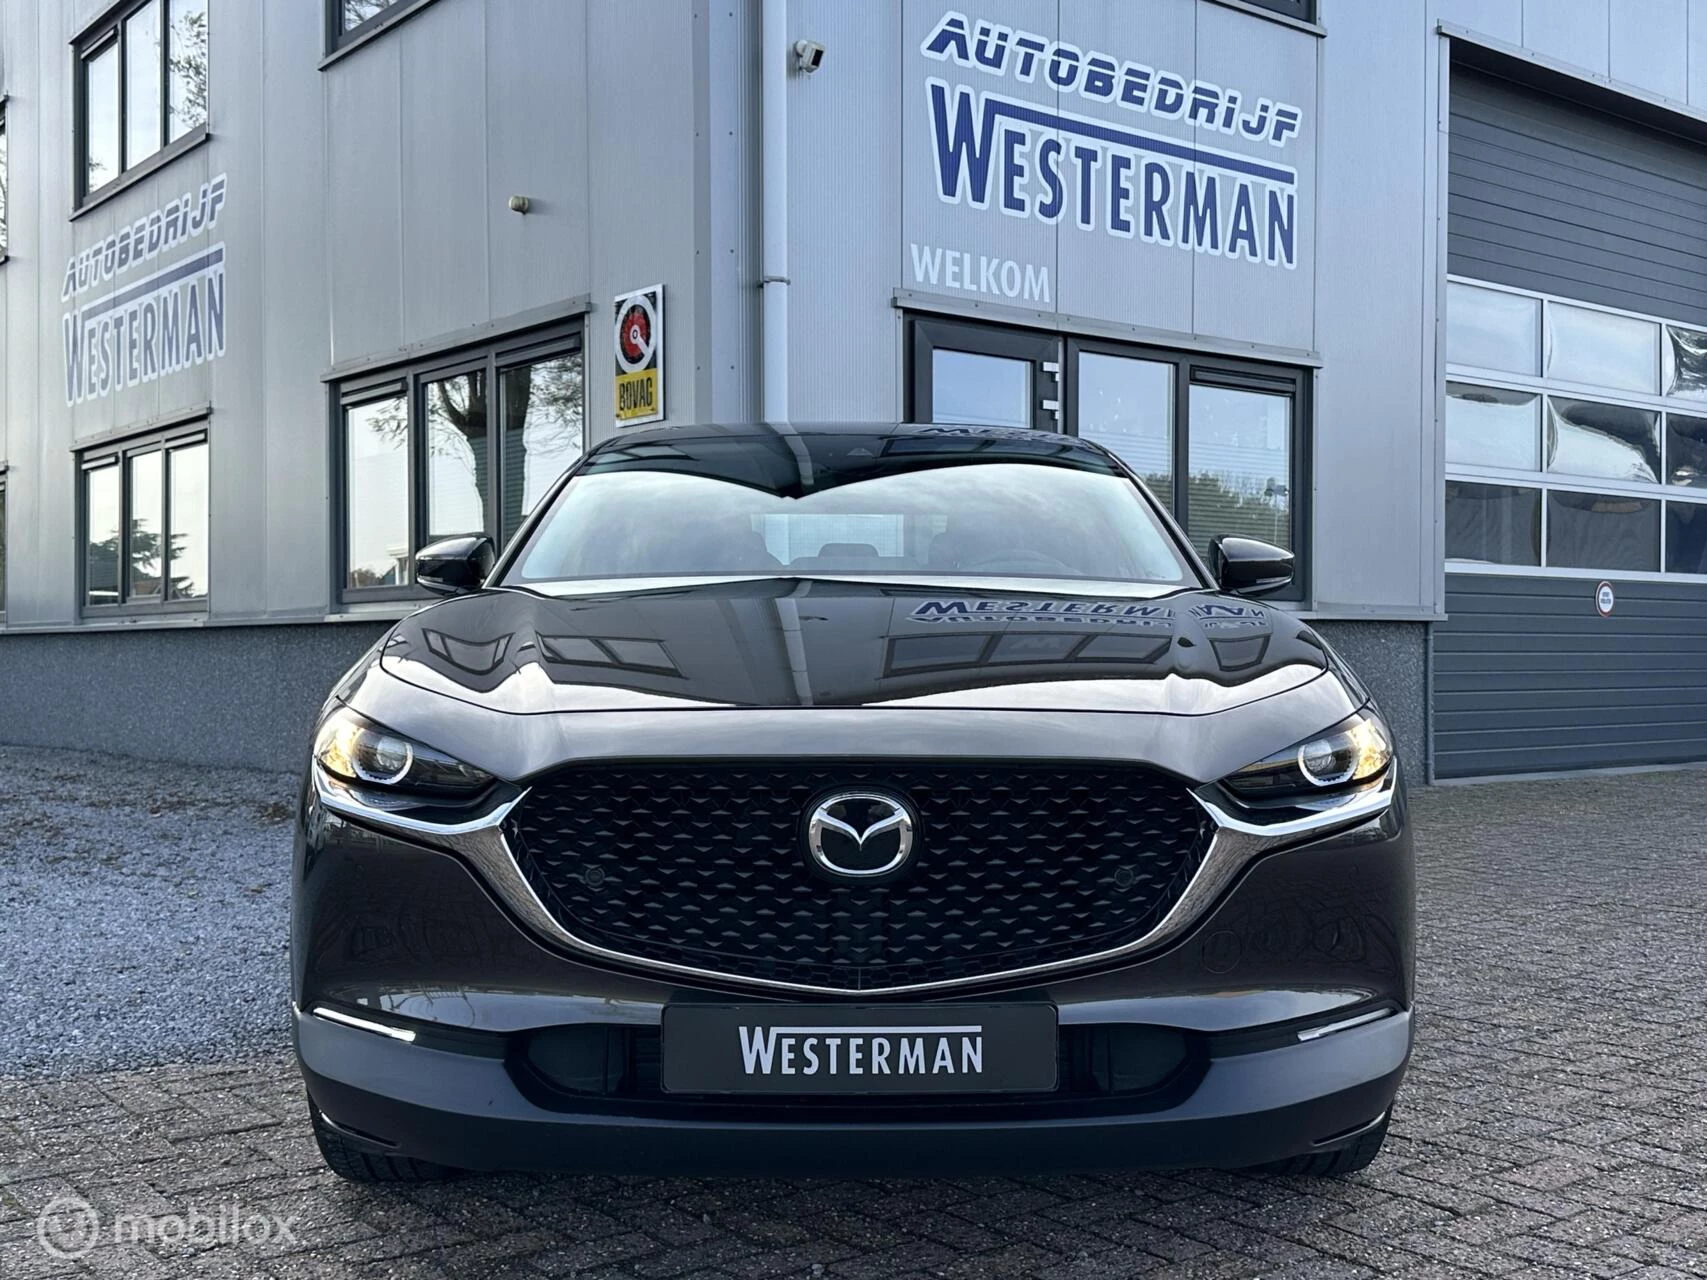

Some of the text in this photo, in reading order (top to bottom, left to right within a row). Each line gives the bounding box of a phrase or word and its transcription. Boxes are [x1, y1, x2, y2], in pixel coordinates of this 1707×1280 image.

[926, 17, 1299, 142] AUTOBEDRIJF
[63, 178, 226, 296] AUTOBEDRIJF
[910, 243, 1051, 303] WELKOM
[618, 376, 653, 412] BOVAG
